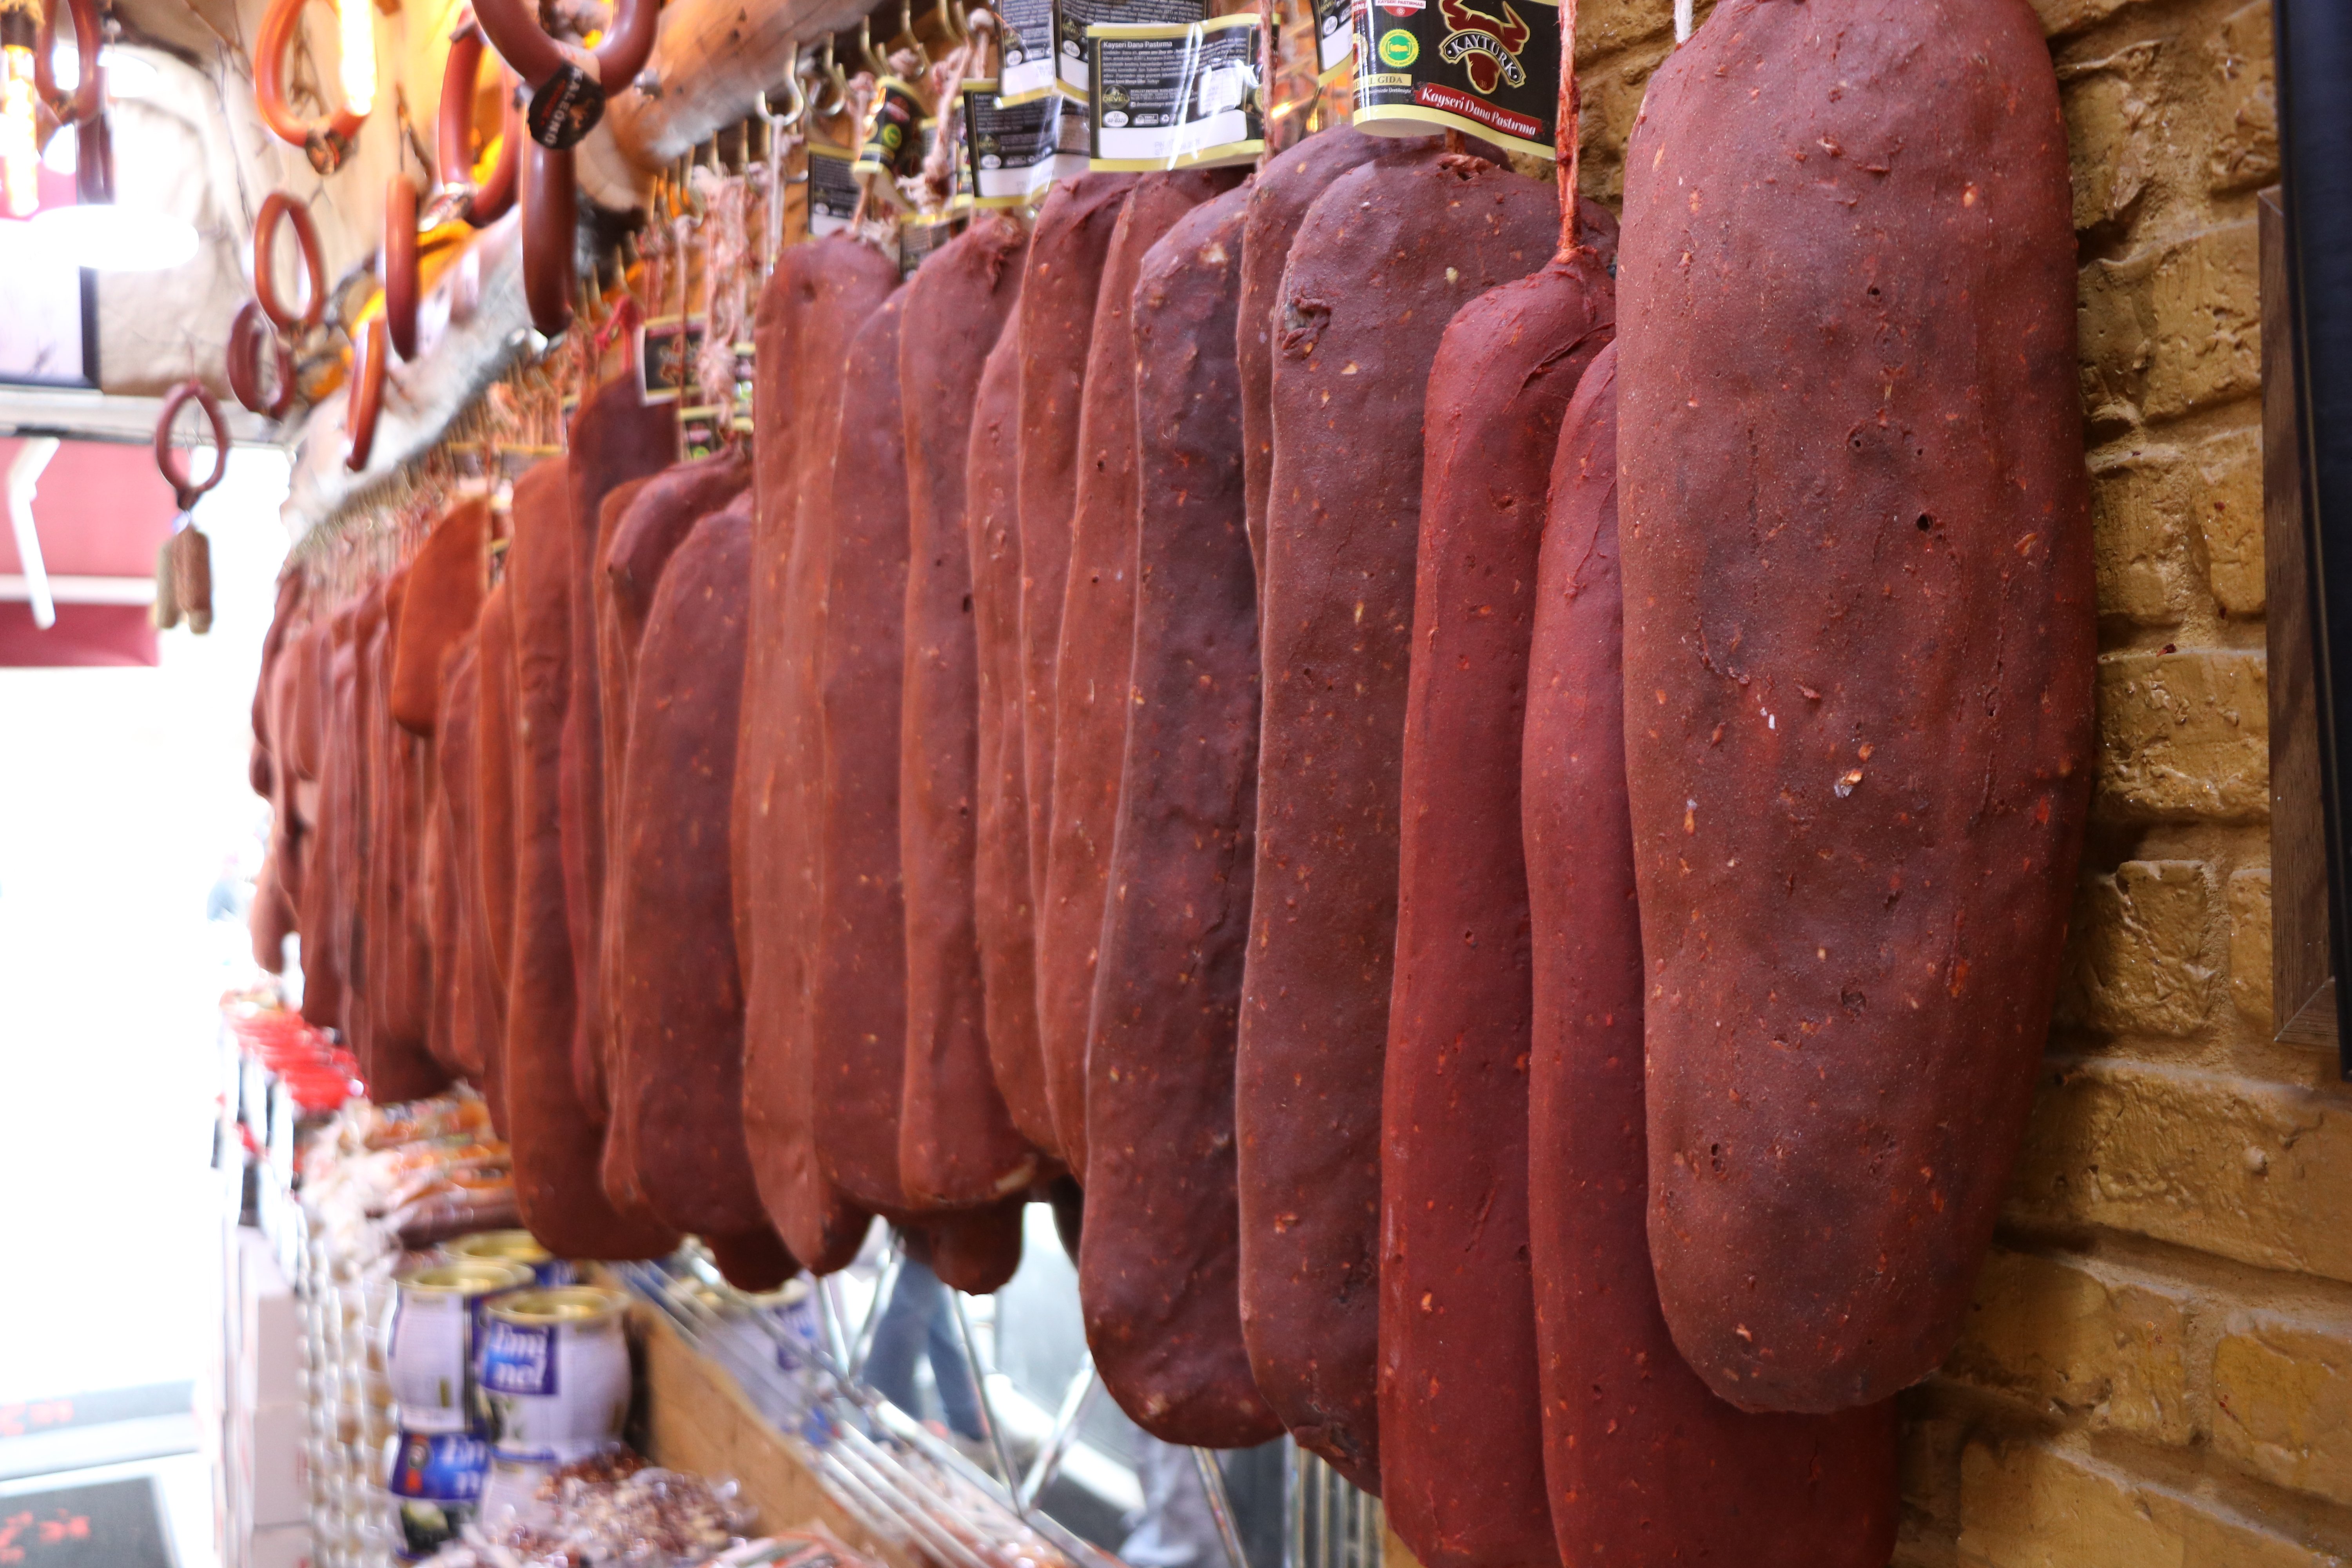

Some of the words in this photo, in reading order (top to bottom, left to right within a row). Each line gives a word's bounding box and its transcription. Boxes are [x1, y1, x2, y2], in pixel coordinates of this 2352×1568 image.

[1451, 34, 1518, 77] KAYTÜRK
[1421, 87, 1465, 110] Kayseri
[1465, 99, 1491, 121] Dana
[1492, 111, 1536, 136] Pastırma
